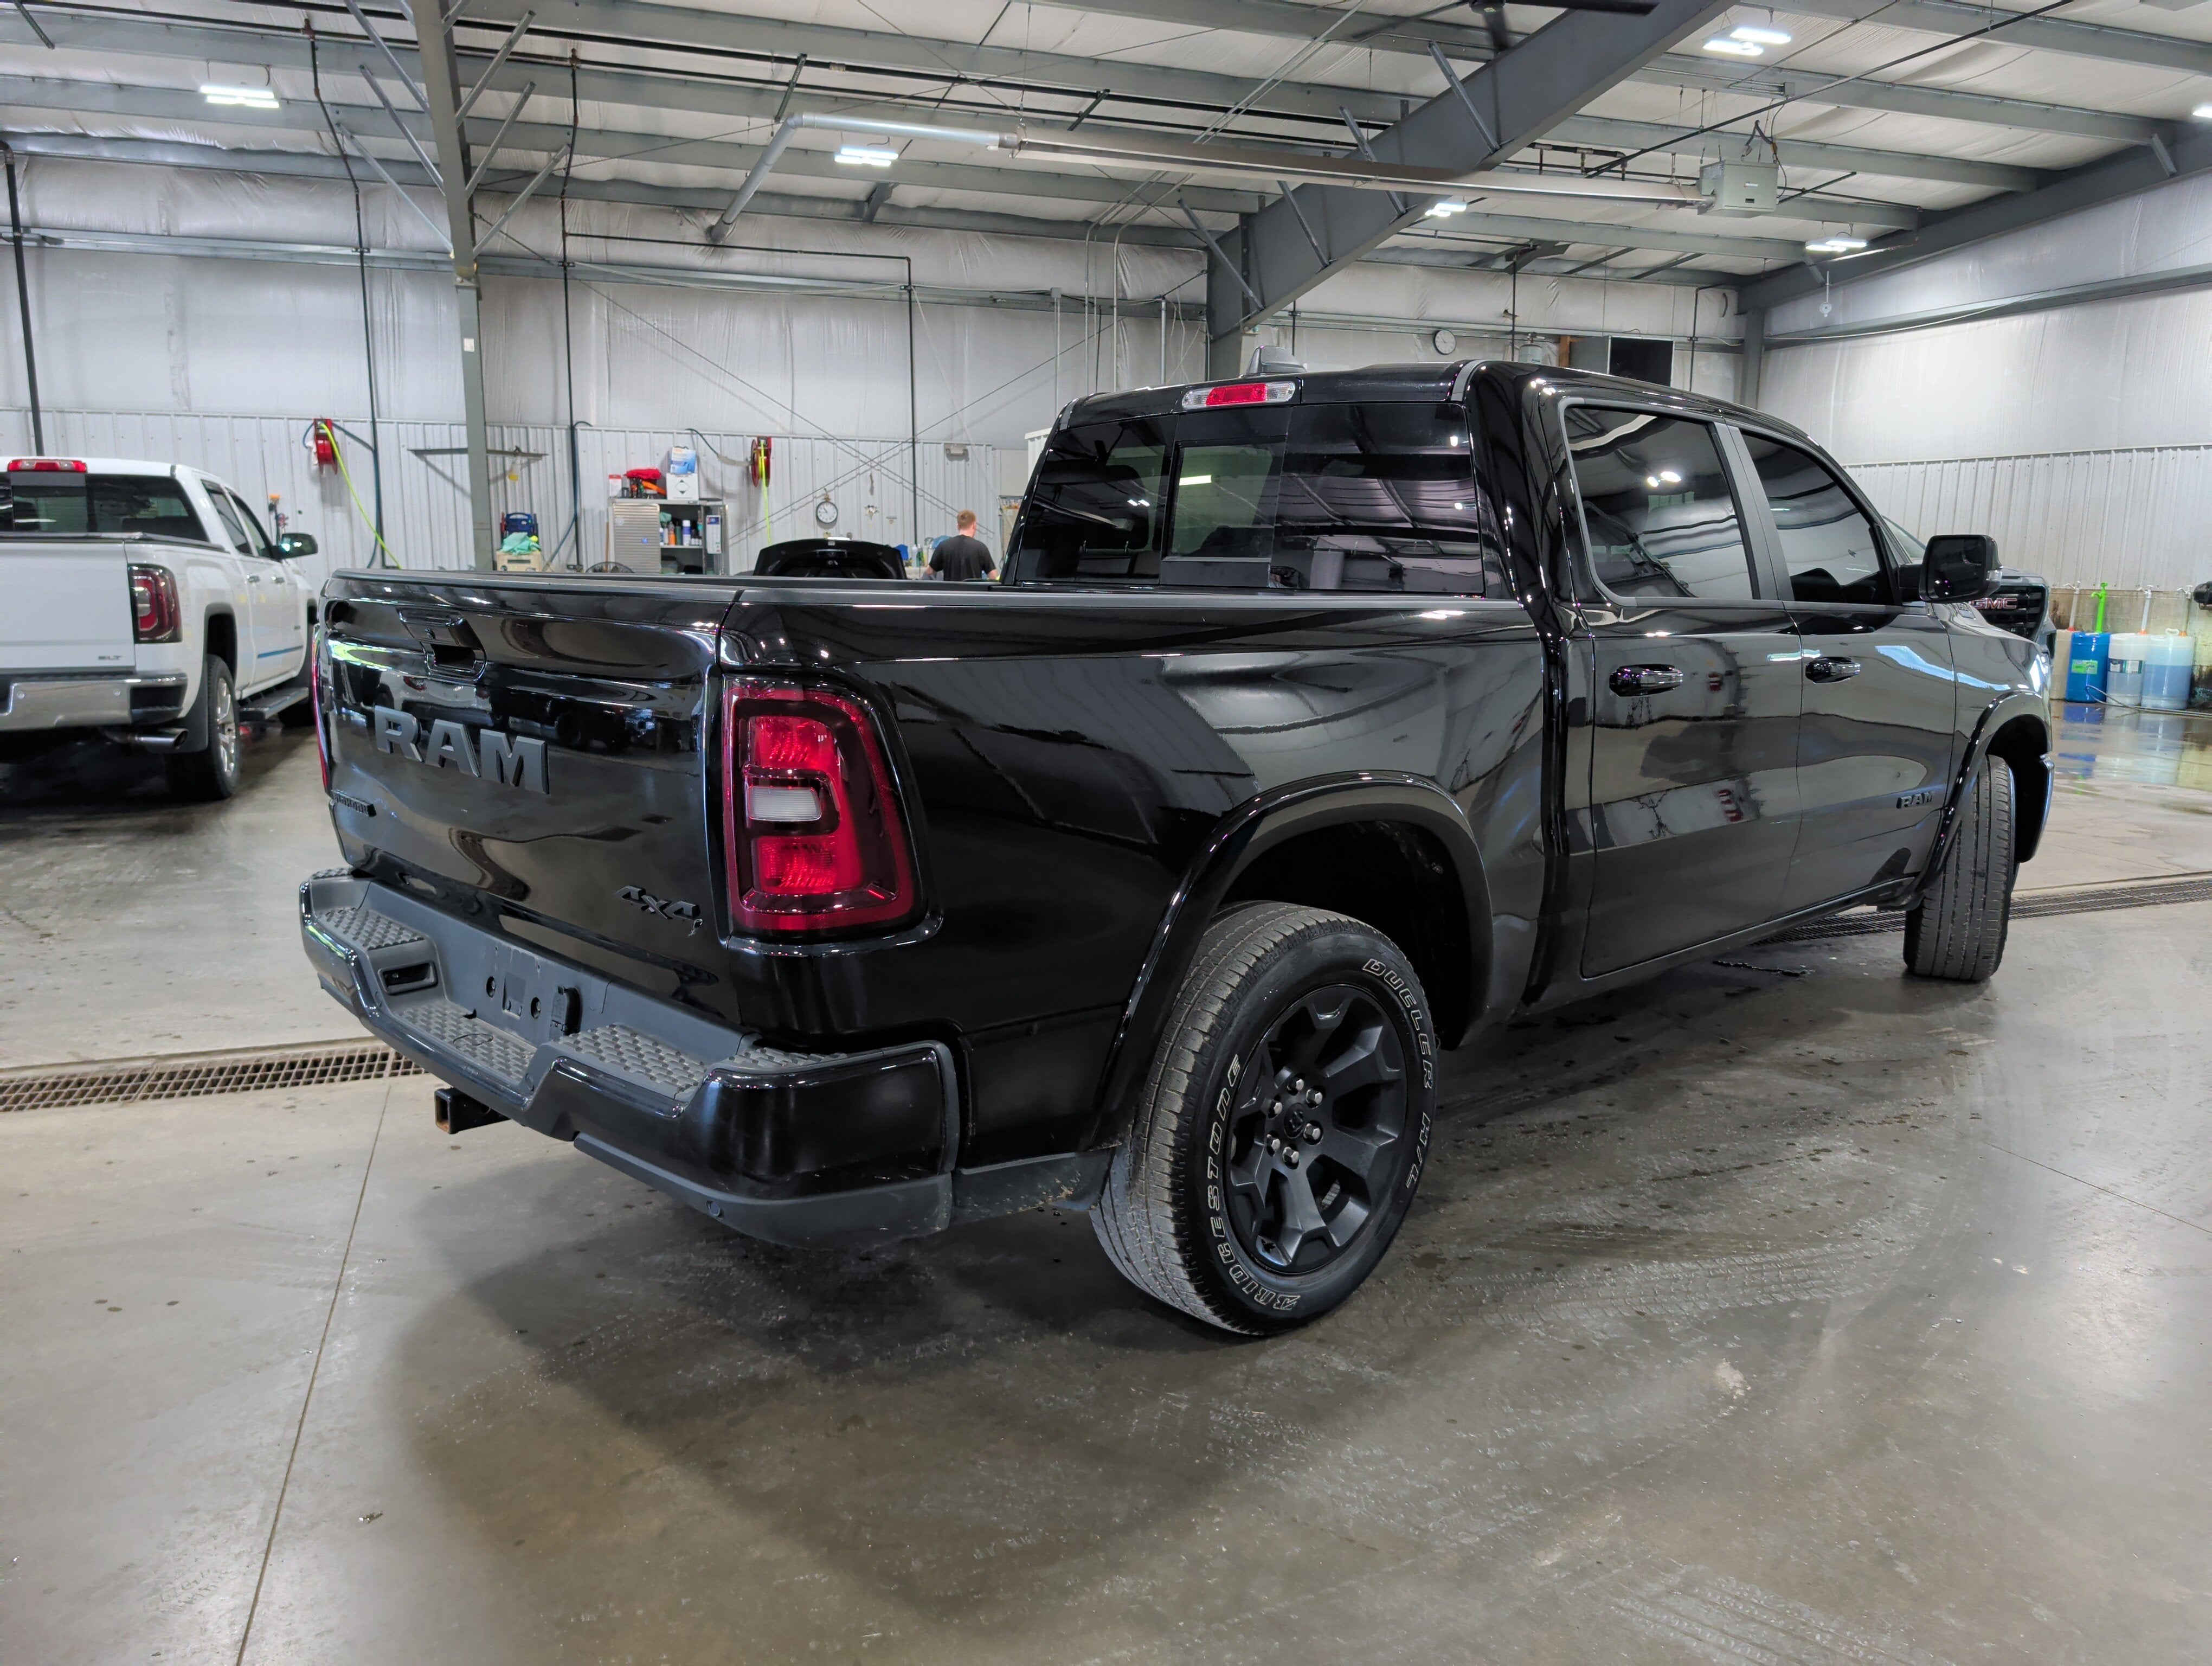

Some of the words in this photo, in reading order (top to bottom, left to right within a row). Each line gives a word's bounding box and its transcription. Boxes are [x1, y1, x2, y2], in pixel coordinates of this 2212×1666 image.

[1968, 597, 2017, 610] GMC
[375, 704, 550, 795] RAM
[1896, 791, 1934, 809] RAM
[1361, 958, 1433, 1090] DUELER
[1207, 1053, 1301, 1312] BRIDGESTONE
